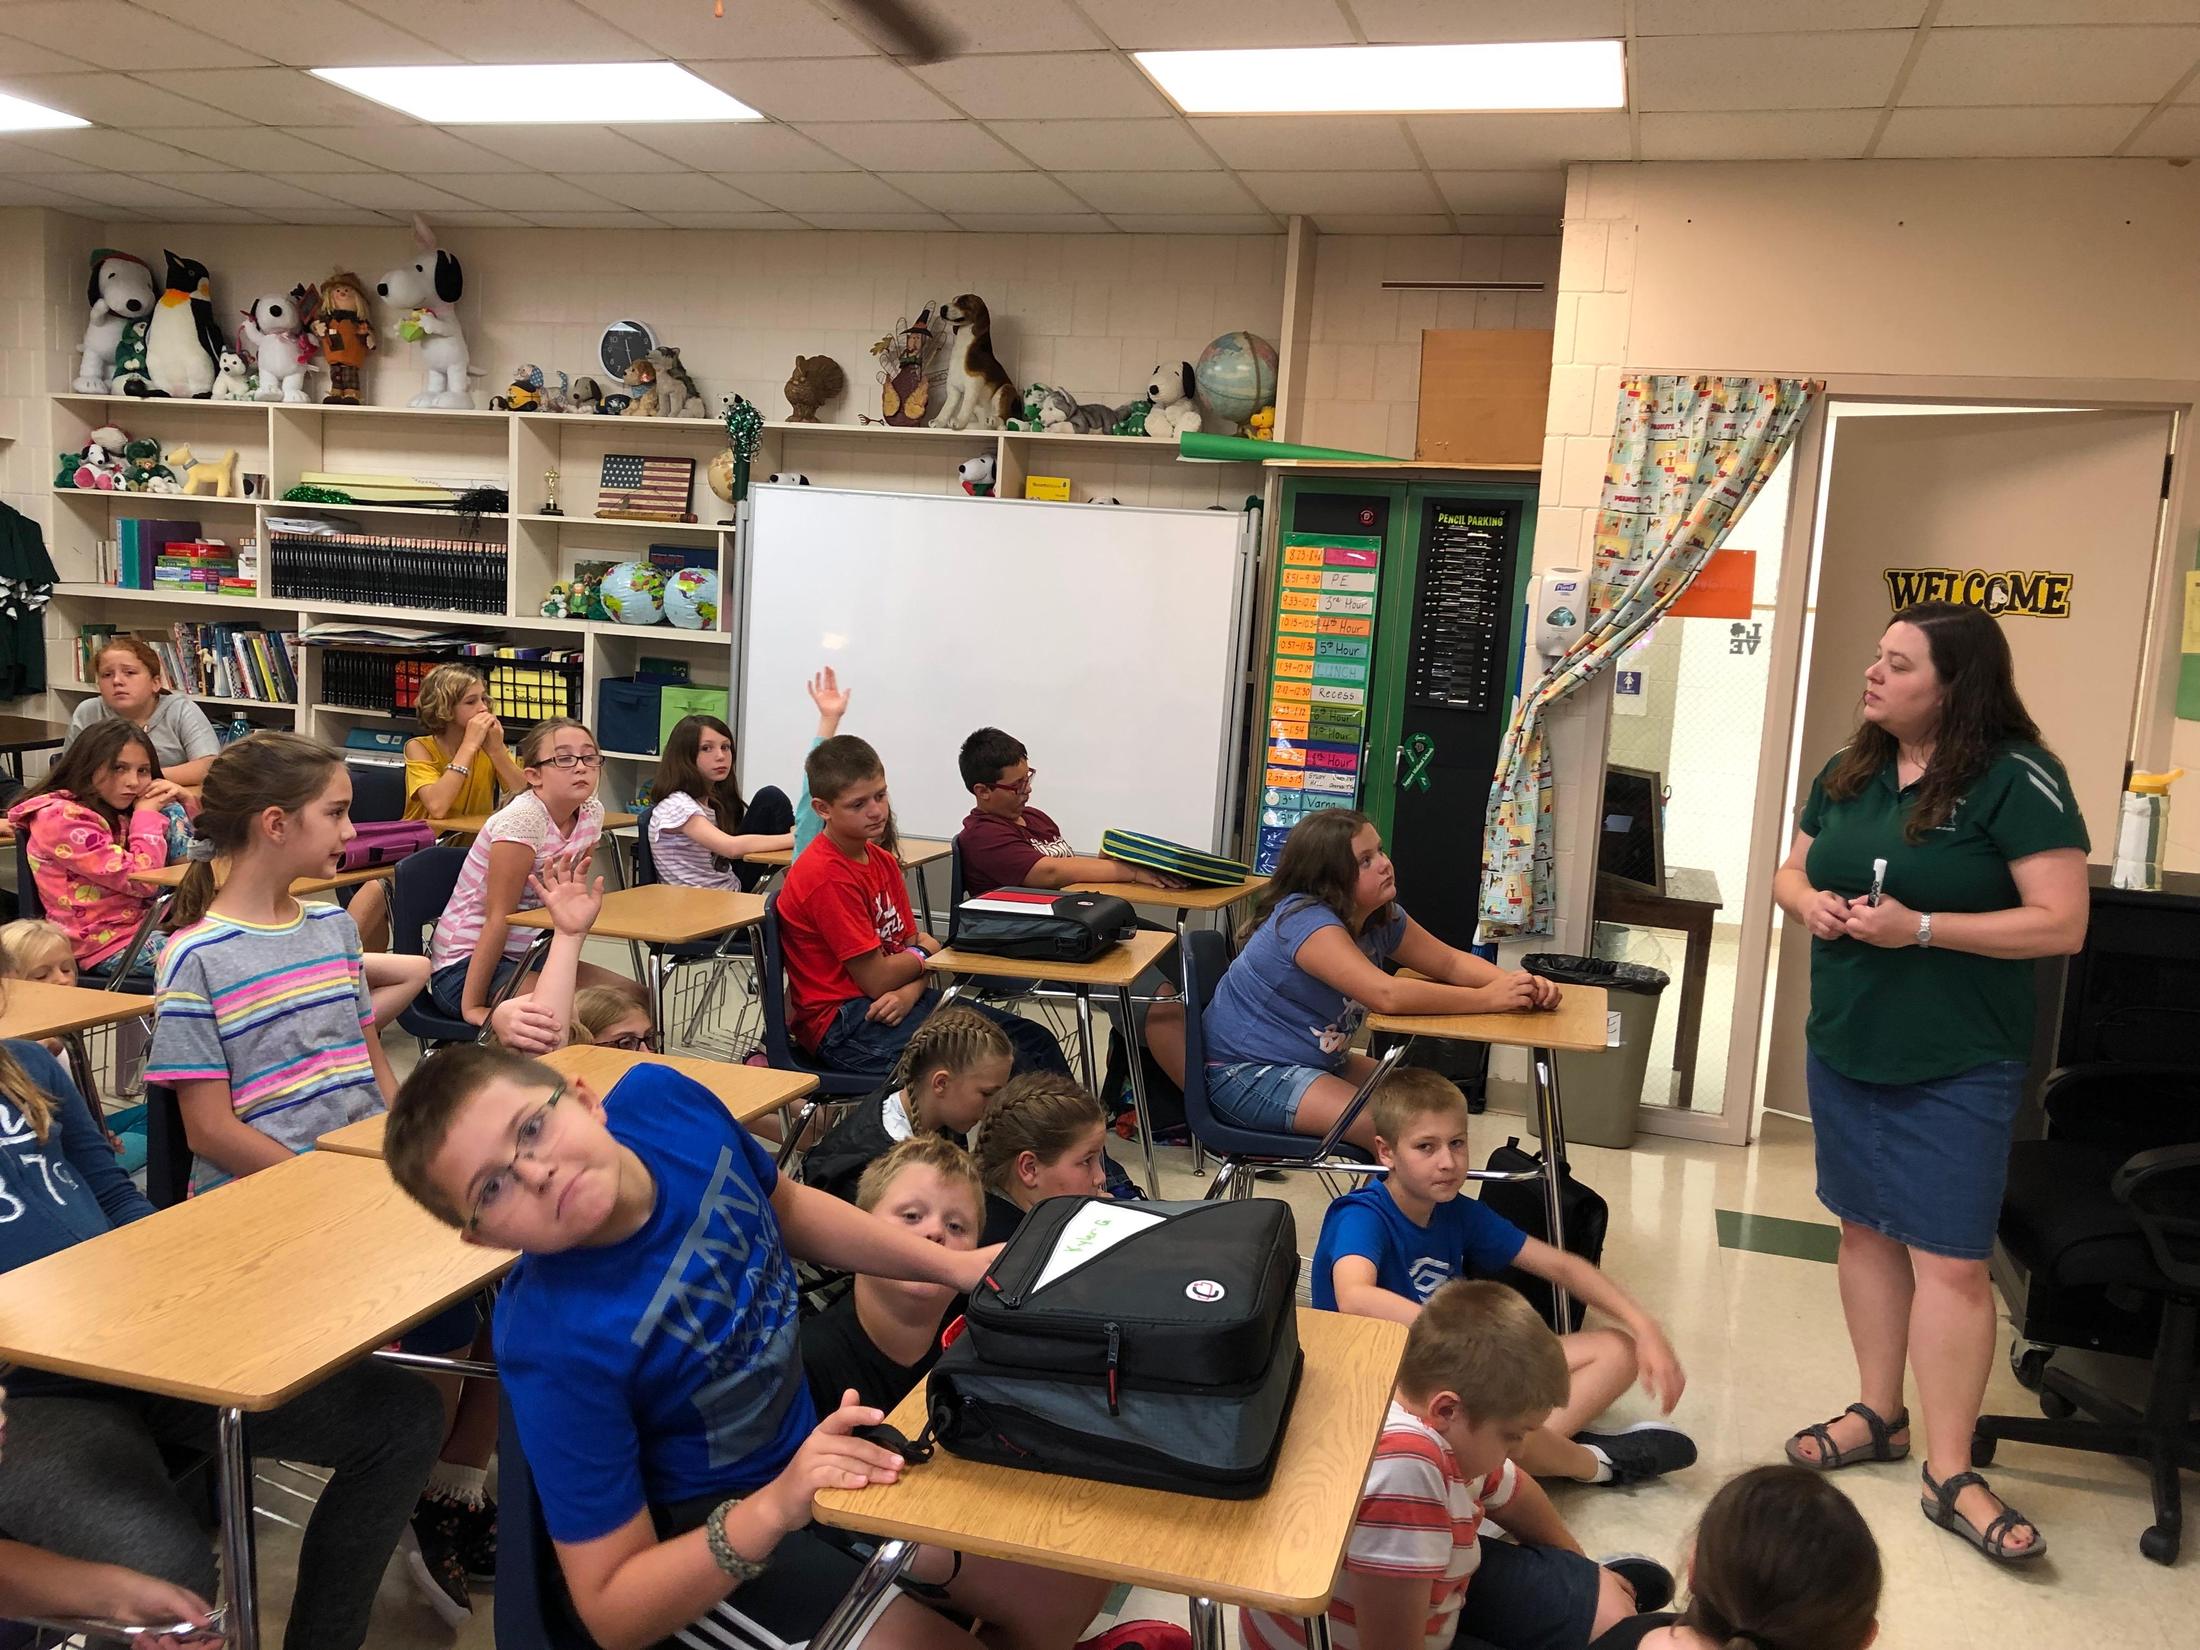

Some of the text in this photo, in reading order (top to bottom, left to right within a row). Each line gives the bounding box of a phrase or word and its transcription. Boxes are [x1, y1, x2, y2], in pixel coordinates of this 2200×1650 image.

[1438, 512, 1504, 527] PENCIL PARKING
[1331, 573, 1350, 587] PE
[1887, 571, 2069, 615] WELCOME
[1345, 598, 1368, 610] Hour
[1340, 619, 1364, 633] Hour
[1336, 642, 1360, 656] Hour
[1319, 687, 1355, 701] Recess
[1329, 709, 1351, 722] Hour
[1328, 726, 1352, 740] Hour
[1328, 753, 1354, 768] Hour
